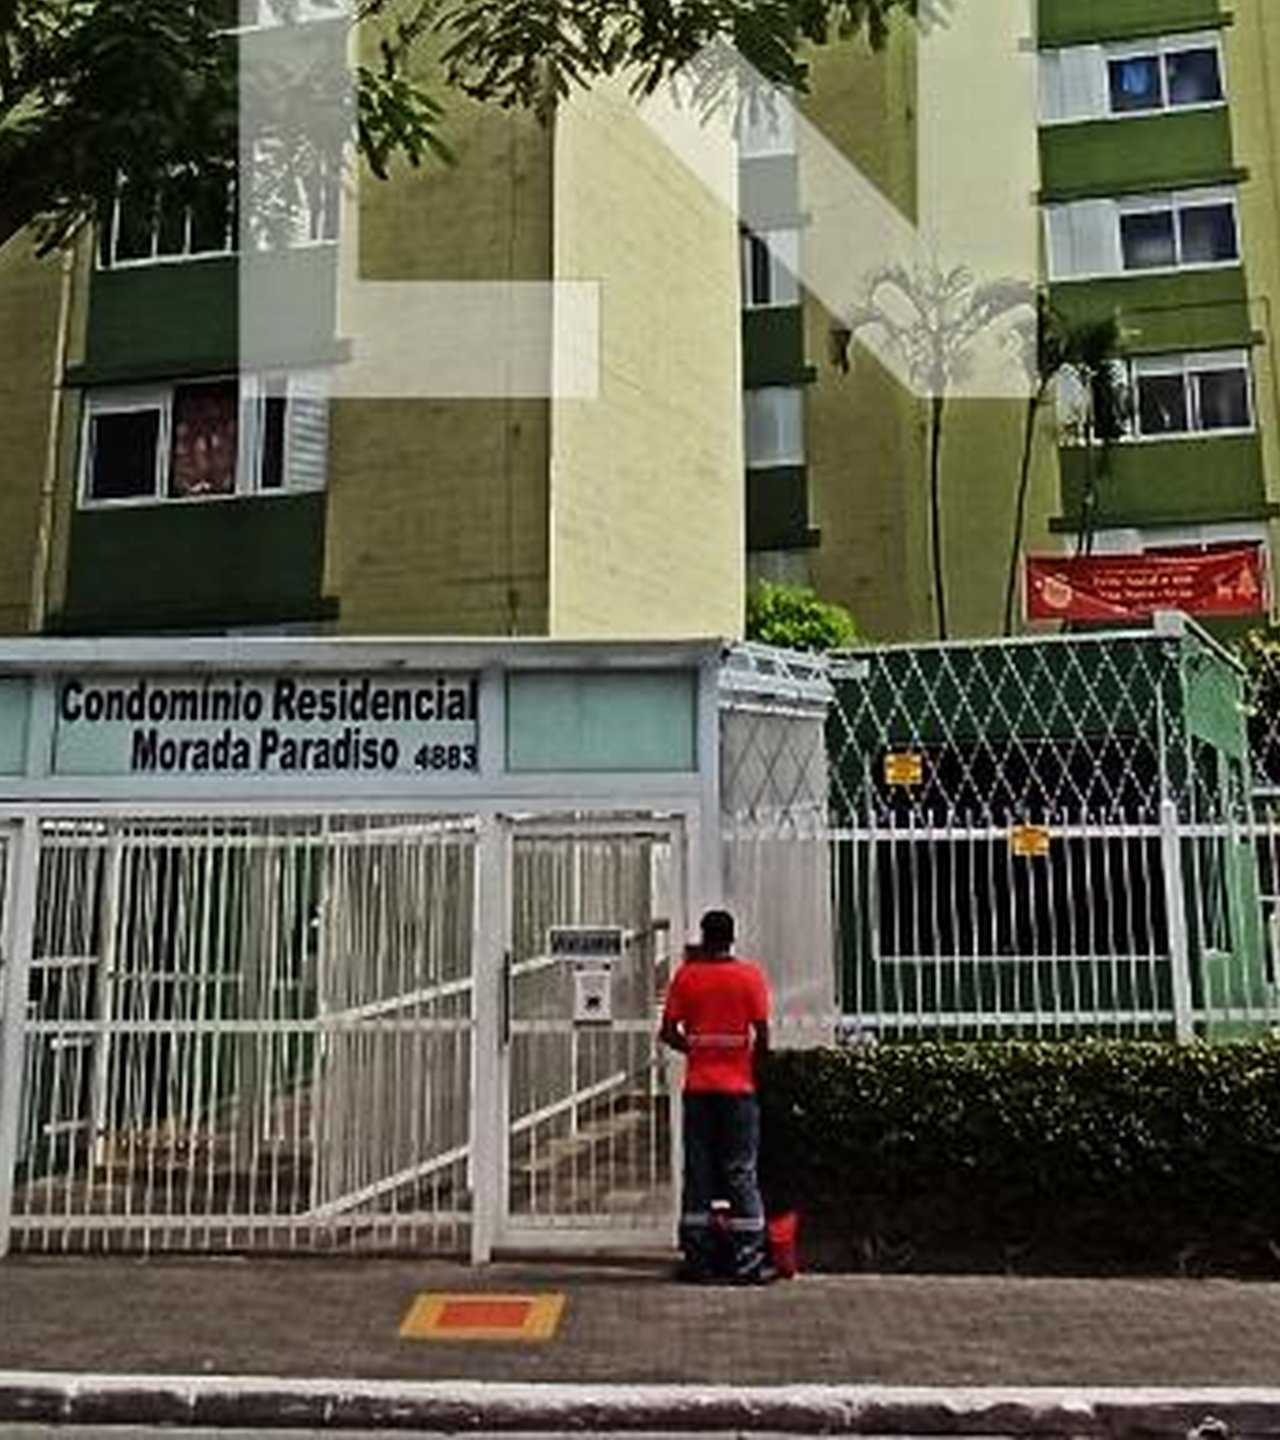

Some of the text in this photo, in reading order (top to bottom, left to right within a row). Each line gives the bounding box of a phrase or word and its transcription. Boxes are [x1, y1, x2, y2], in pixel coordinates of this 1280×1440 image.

[273, 677, 478, 721] Residencial
[131, 727, 477, 770] Morada Paradiso 4883
